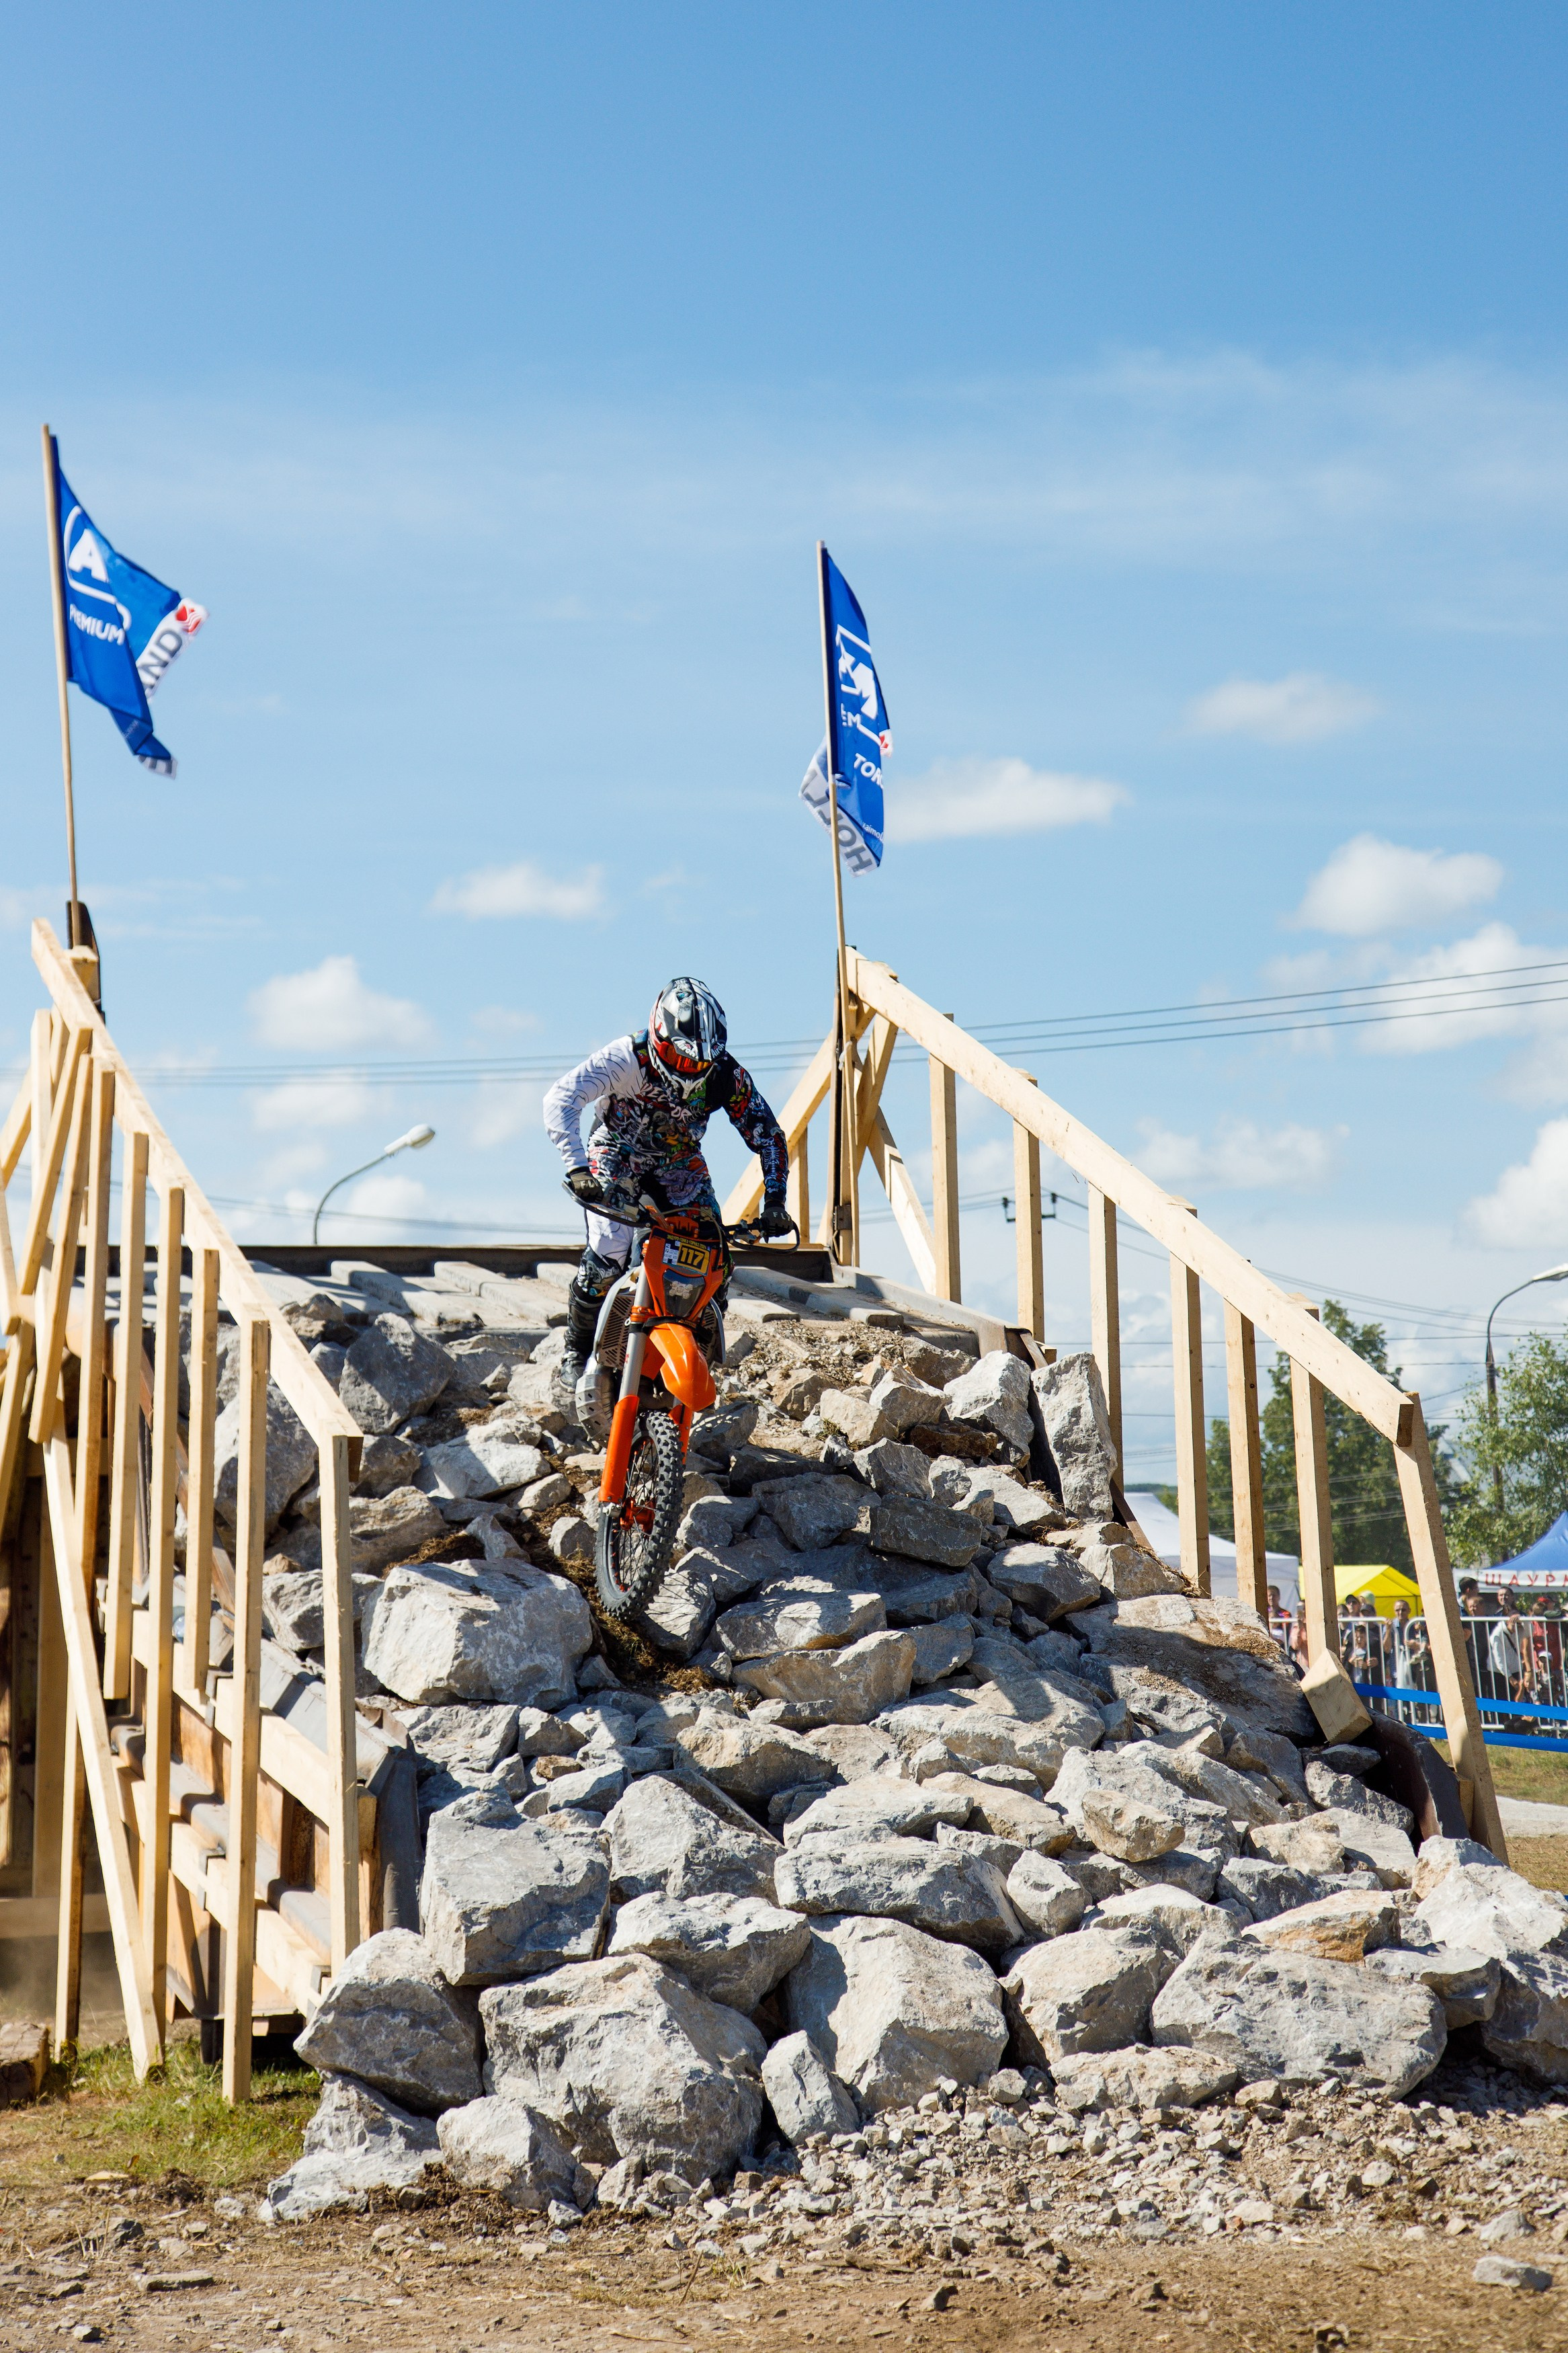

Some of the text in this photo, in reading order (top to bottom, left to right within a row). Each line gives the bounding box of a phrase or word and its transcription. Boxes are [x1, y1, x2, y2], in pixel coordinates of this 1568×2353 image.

[69, 603, 126, 646] PEMIUM
[854, 752, 884, 789] TOR
[673, 1039, 725, 1059] Airoh Airoh
[680, 1247, 704, 1266] 117
